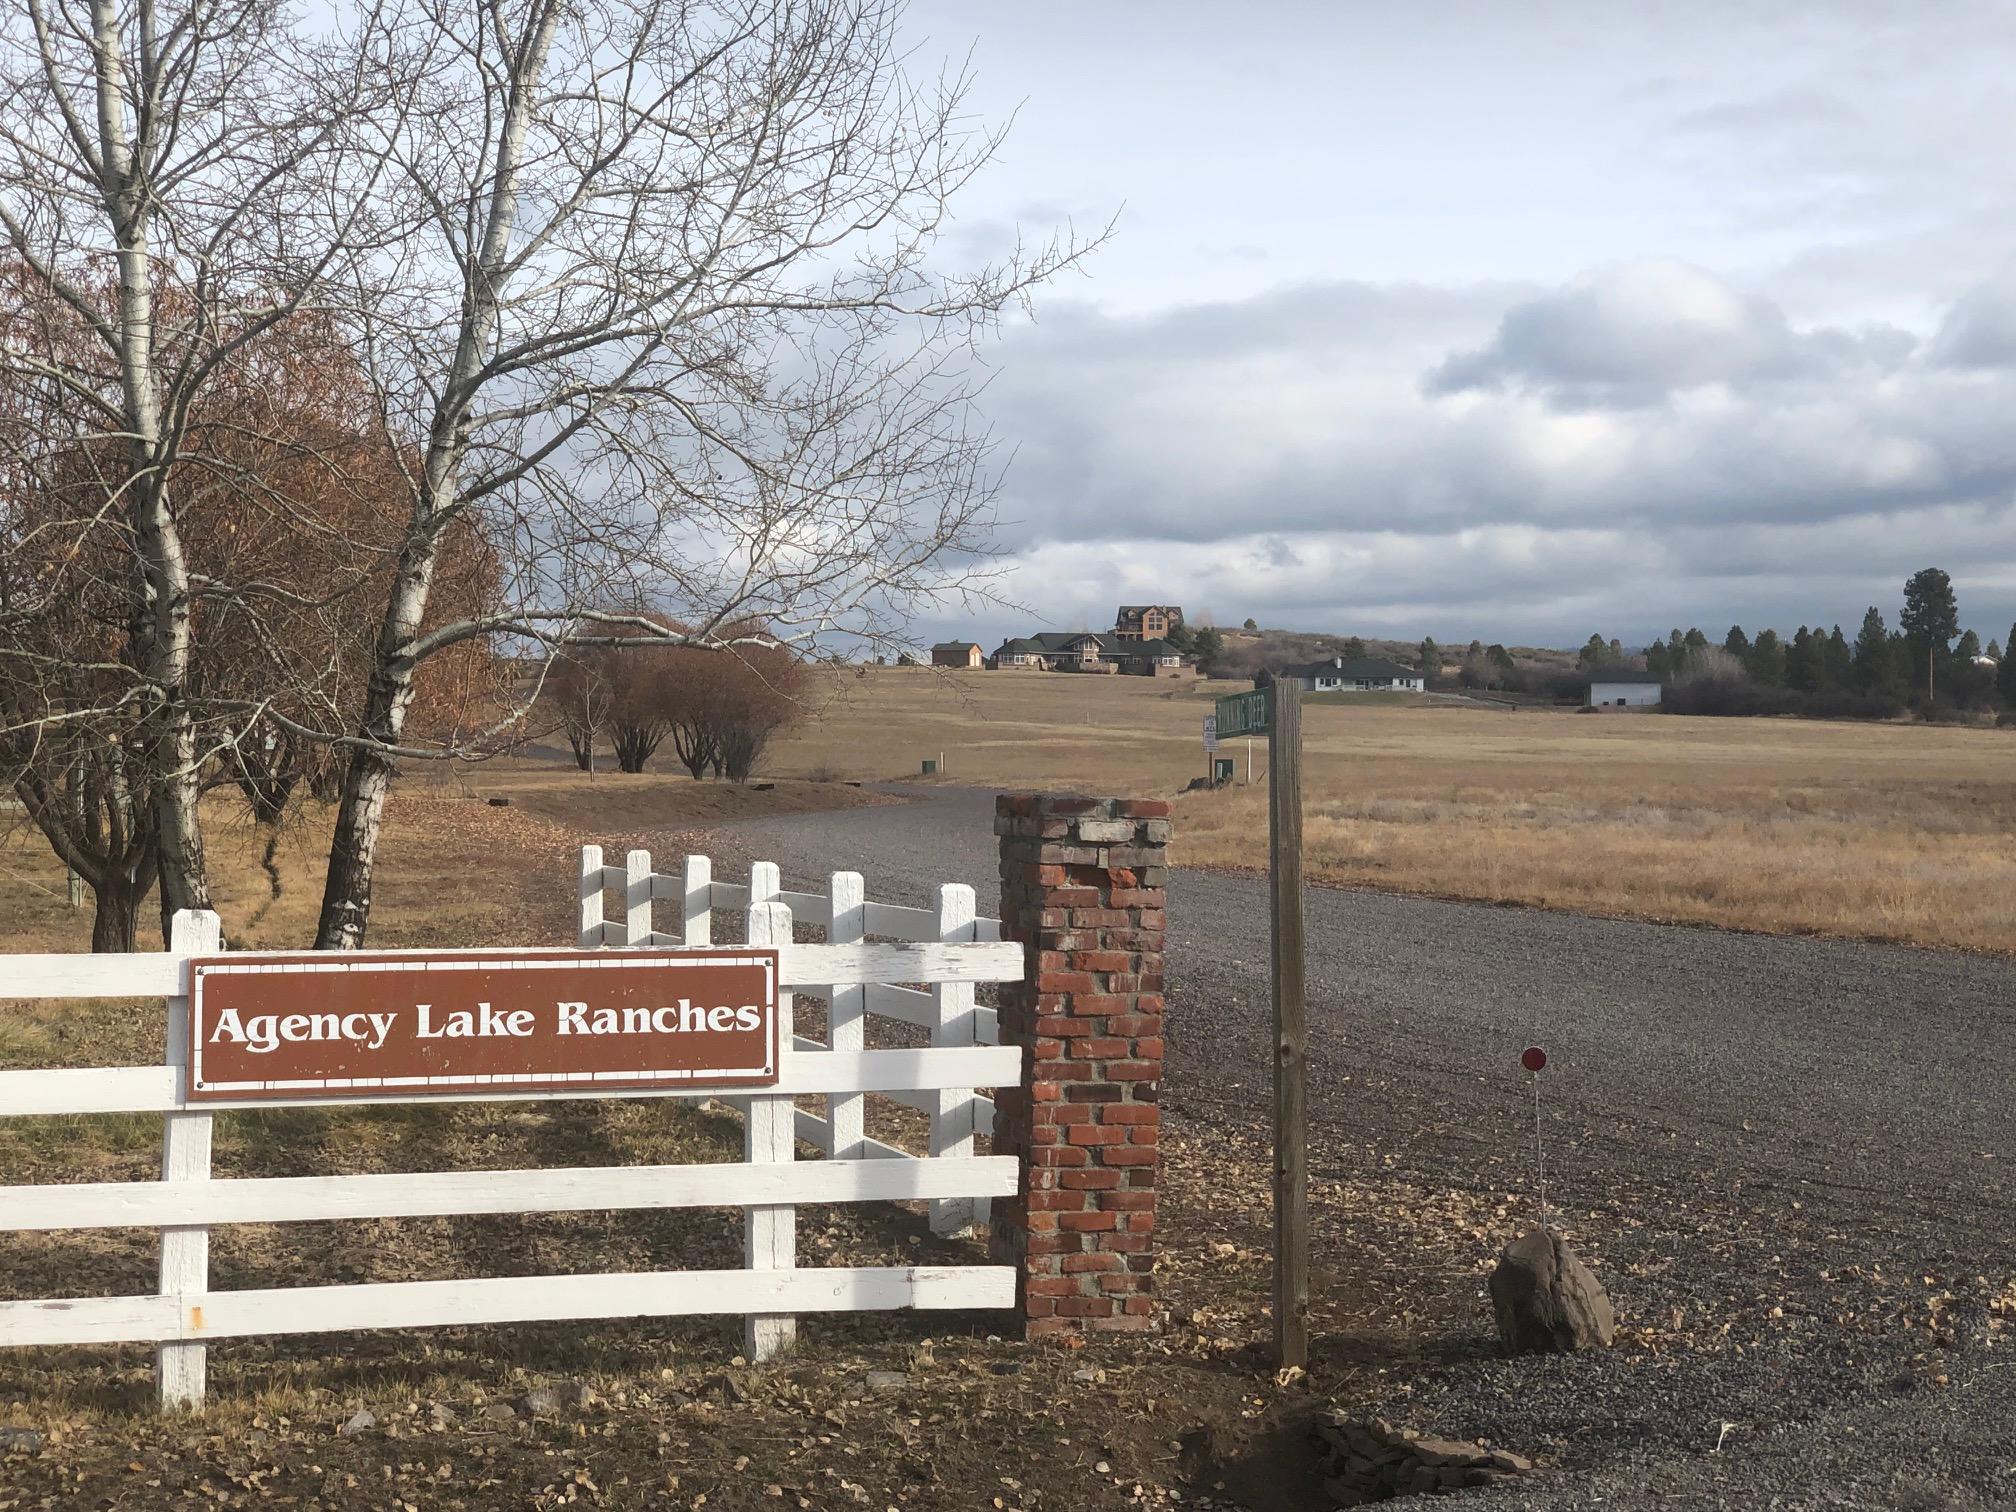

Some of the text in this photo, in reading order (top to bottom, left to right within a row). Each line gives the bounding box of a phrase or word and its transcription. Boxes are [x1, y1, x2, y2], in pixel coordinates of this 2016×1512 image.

[1248, 694, 1265, 728] DEER
[208, 998, 761, 1053] Agency Lake Ranches
